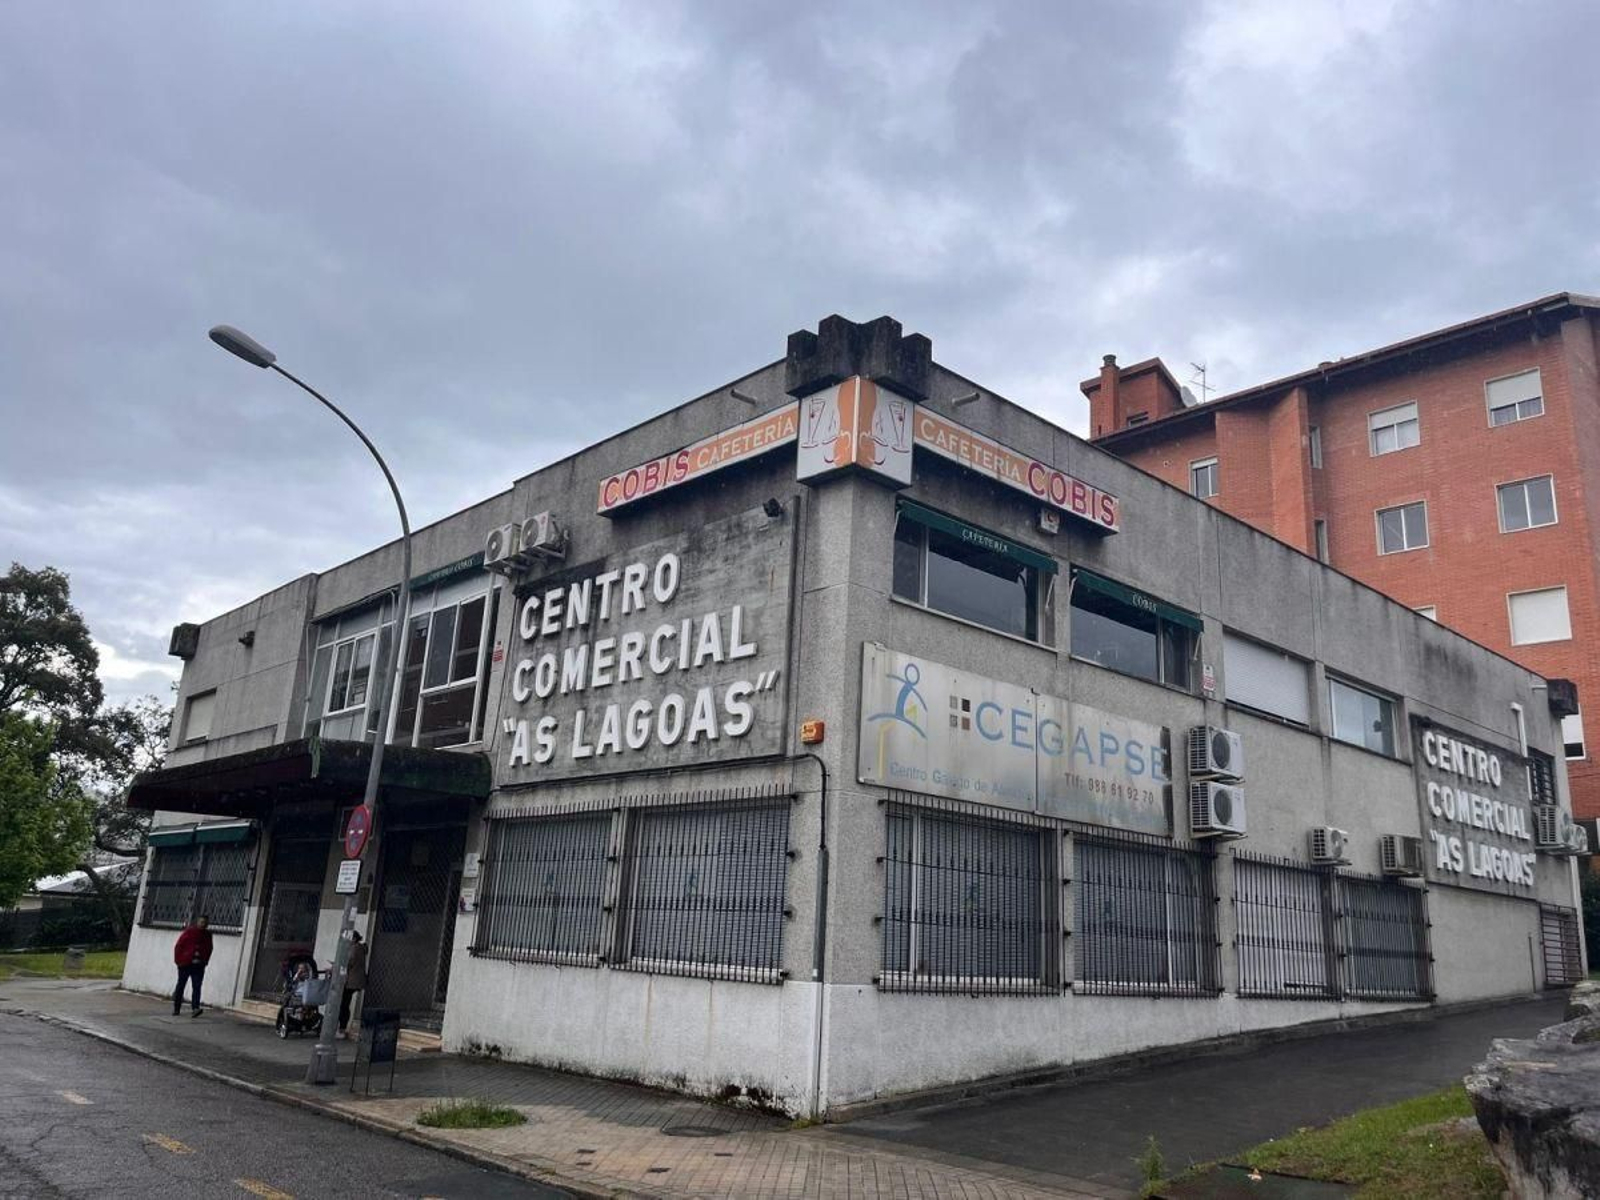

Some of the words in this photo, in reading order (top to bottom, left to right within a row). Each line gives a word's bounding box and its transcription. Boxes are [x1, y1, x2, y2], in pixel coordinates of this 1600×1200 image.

[602, 449, 691, 508] COBIS
[920, 418, 1022, 482] CAFETERÍA
[1027, 461, 1115, 527] COBIS
[519, 552, 681, 641] CENTRO
[512, 605, 758, 703] COMERCIAL
[974, 701, 1168, 783] CEGAPSE
[1422, 730, 1502, 787] CENTRO
[1427, 781, 1532, 840] COMERCIAL
